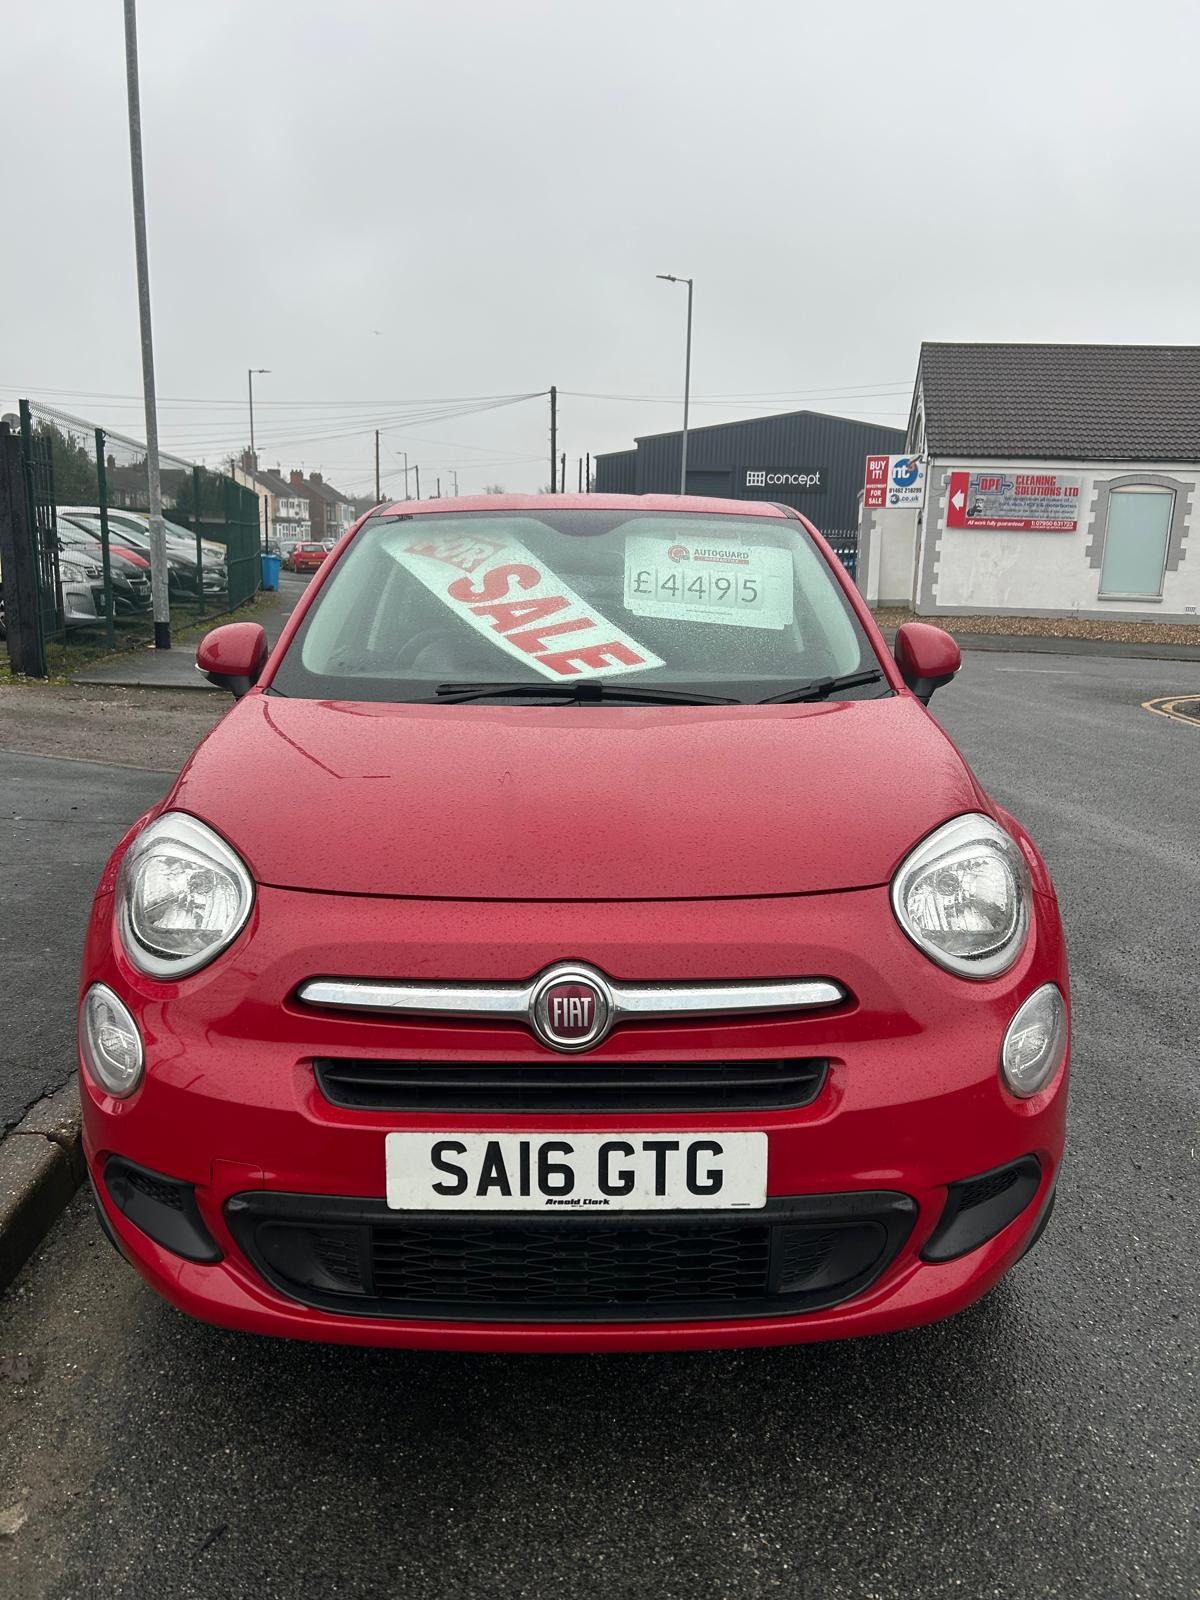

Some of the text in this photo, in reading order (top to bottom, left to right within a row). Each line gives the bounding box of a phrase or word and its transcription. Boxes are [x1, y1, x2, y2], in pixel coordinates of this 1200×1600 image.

[869, 461, 886, 470] BUY
[767, 471, 821, 487] concept
[872, 470, 883, 479] IT!
[1015, 474, 1057, 486] CLEANING
[1014, 486, 1079, 497] SOLUTIONS LTD
[694, 548, 750, 560] AUTOGUARD
[633, 570, 758, 603] £4495
[447, 563, 647, 676] SALE
[553, 997, 592, 1028] FIAT
[430, 1140, 724, 1198] SA16 GTG
